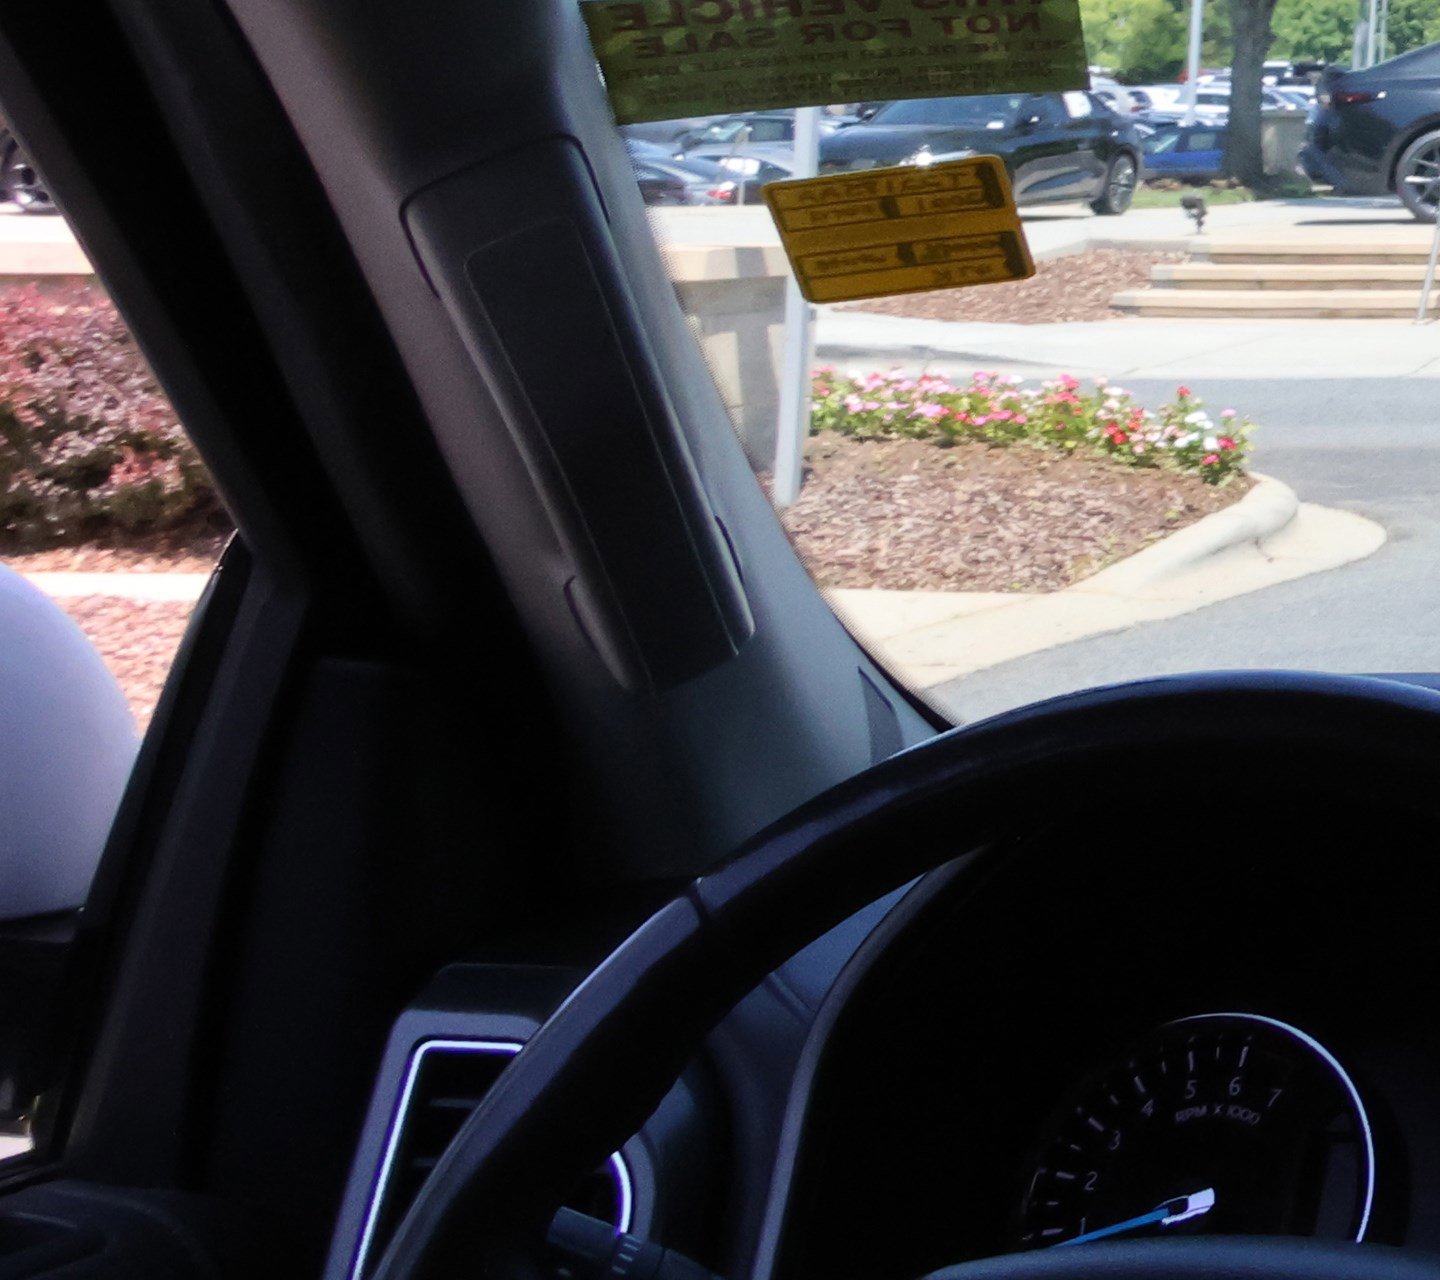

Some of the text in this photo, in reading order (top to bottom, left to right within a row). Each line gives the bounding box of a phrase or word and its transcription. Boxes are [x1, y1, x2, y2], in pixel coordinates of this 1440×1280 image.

[1184, 1080, 1199, 1099] 5
[1229, 1076, 1243, 1097] 6
[1140, 1097, 1156, 1118] 4
[1266, 1088, 1284, 1107] 7
[1174, 1105, 1207, 1122] RPM
[1227, 1104, 1261, 1125] 1000
[1108, 1130, 1122, 1151] 3
[1083, 1171, 1098, 1191] 2
